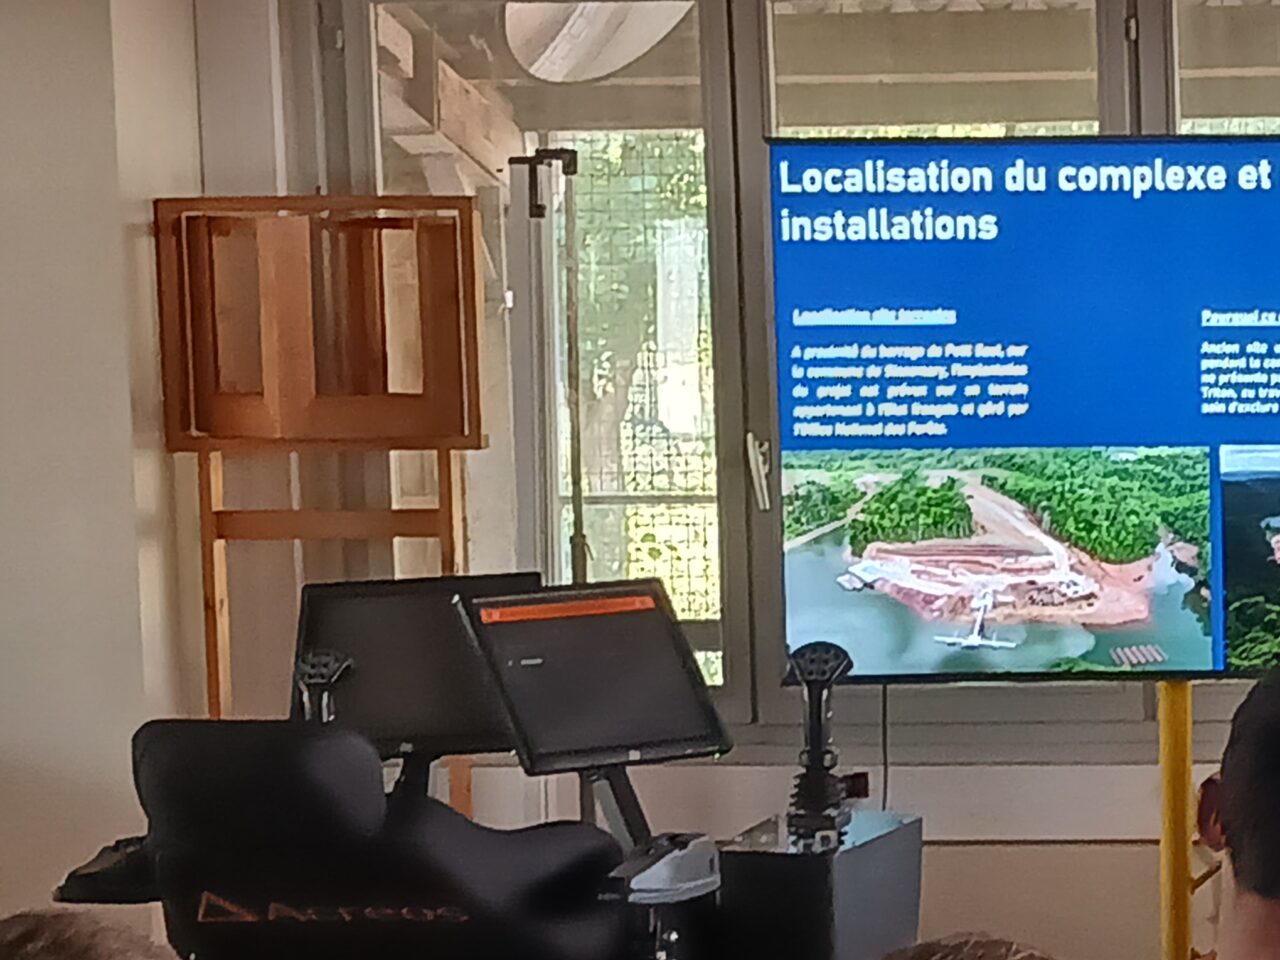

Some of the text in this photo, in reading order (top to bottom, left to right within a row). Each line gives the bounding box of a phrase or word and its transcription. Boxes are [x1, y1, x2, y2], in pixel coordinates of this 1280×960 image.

[780, 159, 993, 193] Localisation
[1005, 159, 1046, 192] du
[1058, 158, 1227, 199] complexe
[1238, 159, 1272, 190] et
[781, 207, 998, 241] installations
